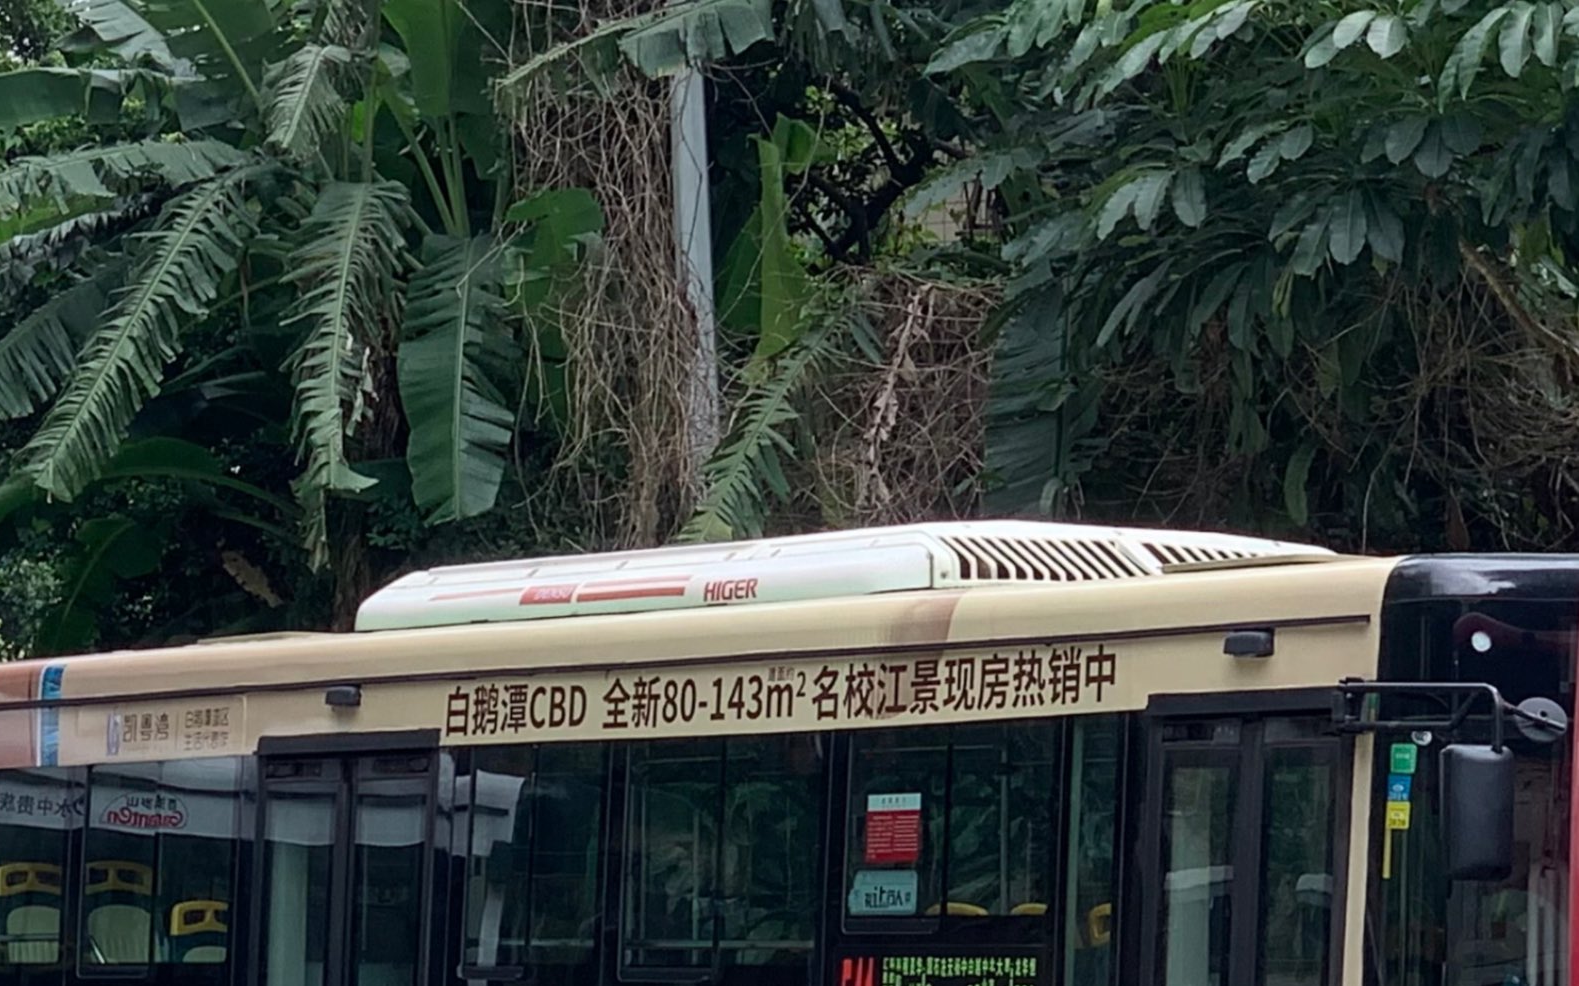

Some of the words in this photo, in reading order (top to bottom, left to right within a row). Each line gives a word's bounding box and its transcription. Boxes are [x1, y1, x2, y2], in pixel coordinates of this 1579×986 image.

[703, 578, 759, 602] HIGER
[445, 683, 587, 737] 白鹅潭CBD
